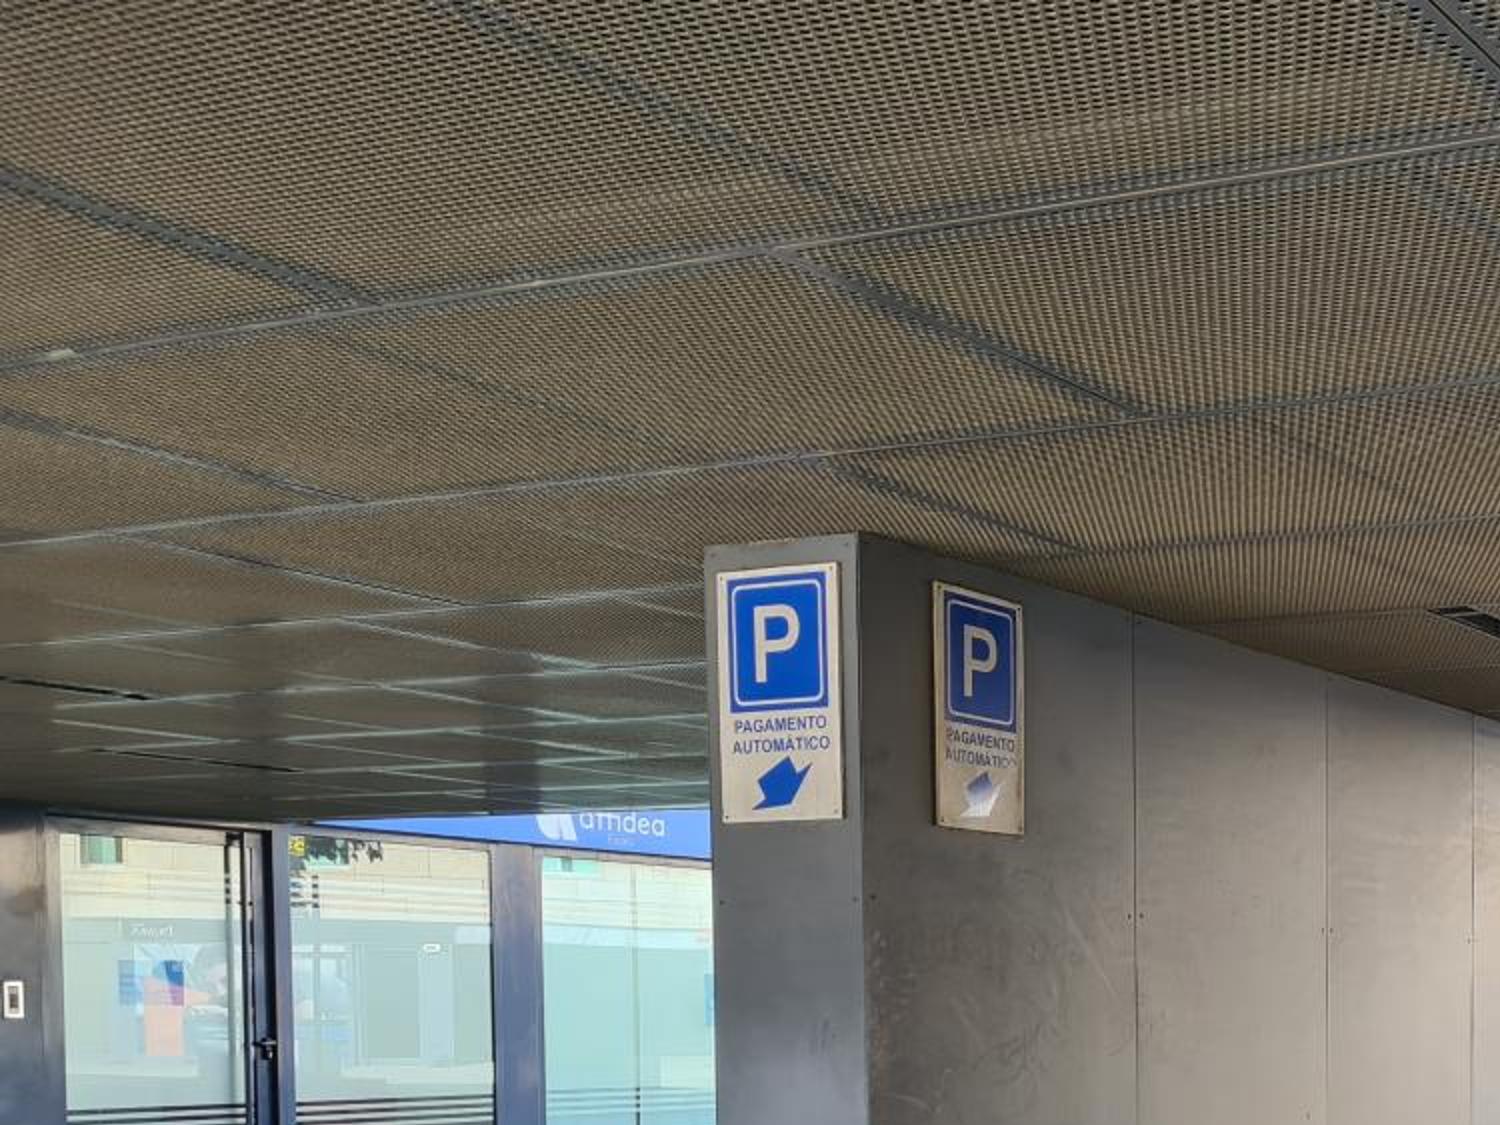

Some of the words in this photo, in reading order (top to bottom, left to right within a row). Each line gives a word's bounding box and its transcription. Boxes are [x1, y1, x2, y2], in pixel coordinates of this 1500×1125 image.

[754, 603, 800, 683] P
[963, 624, 998, 698] P
[735, 715, 828, 733] PAGAMENTO
[733, 734, 831, 755] AUTOMÁTICO
[946, 726, 1015, 752] PAGAMENTO
